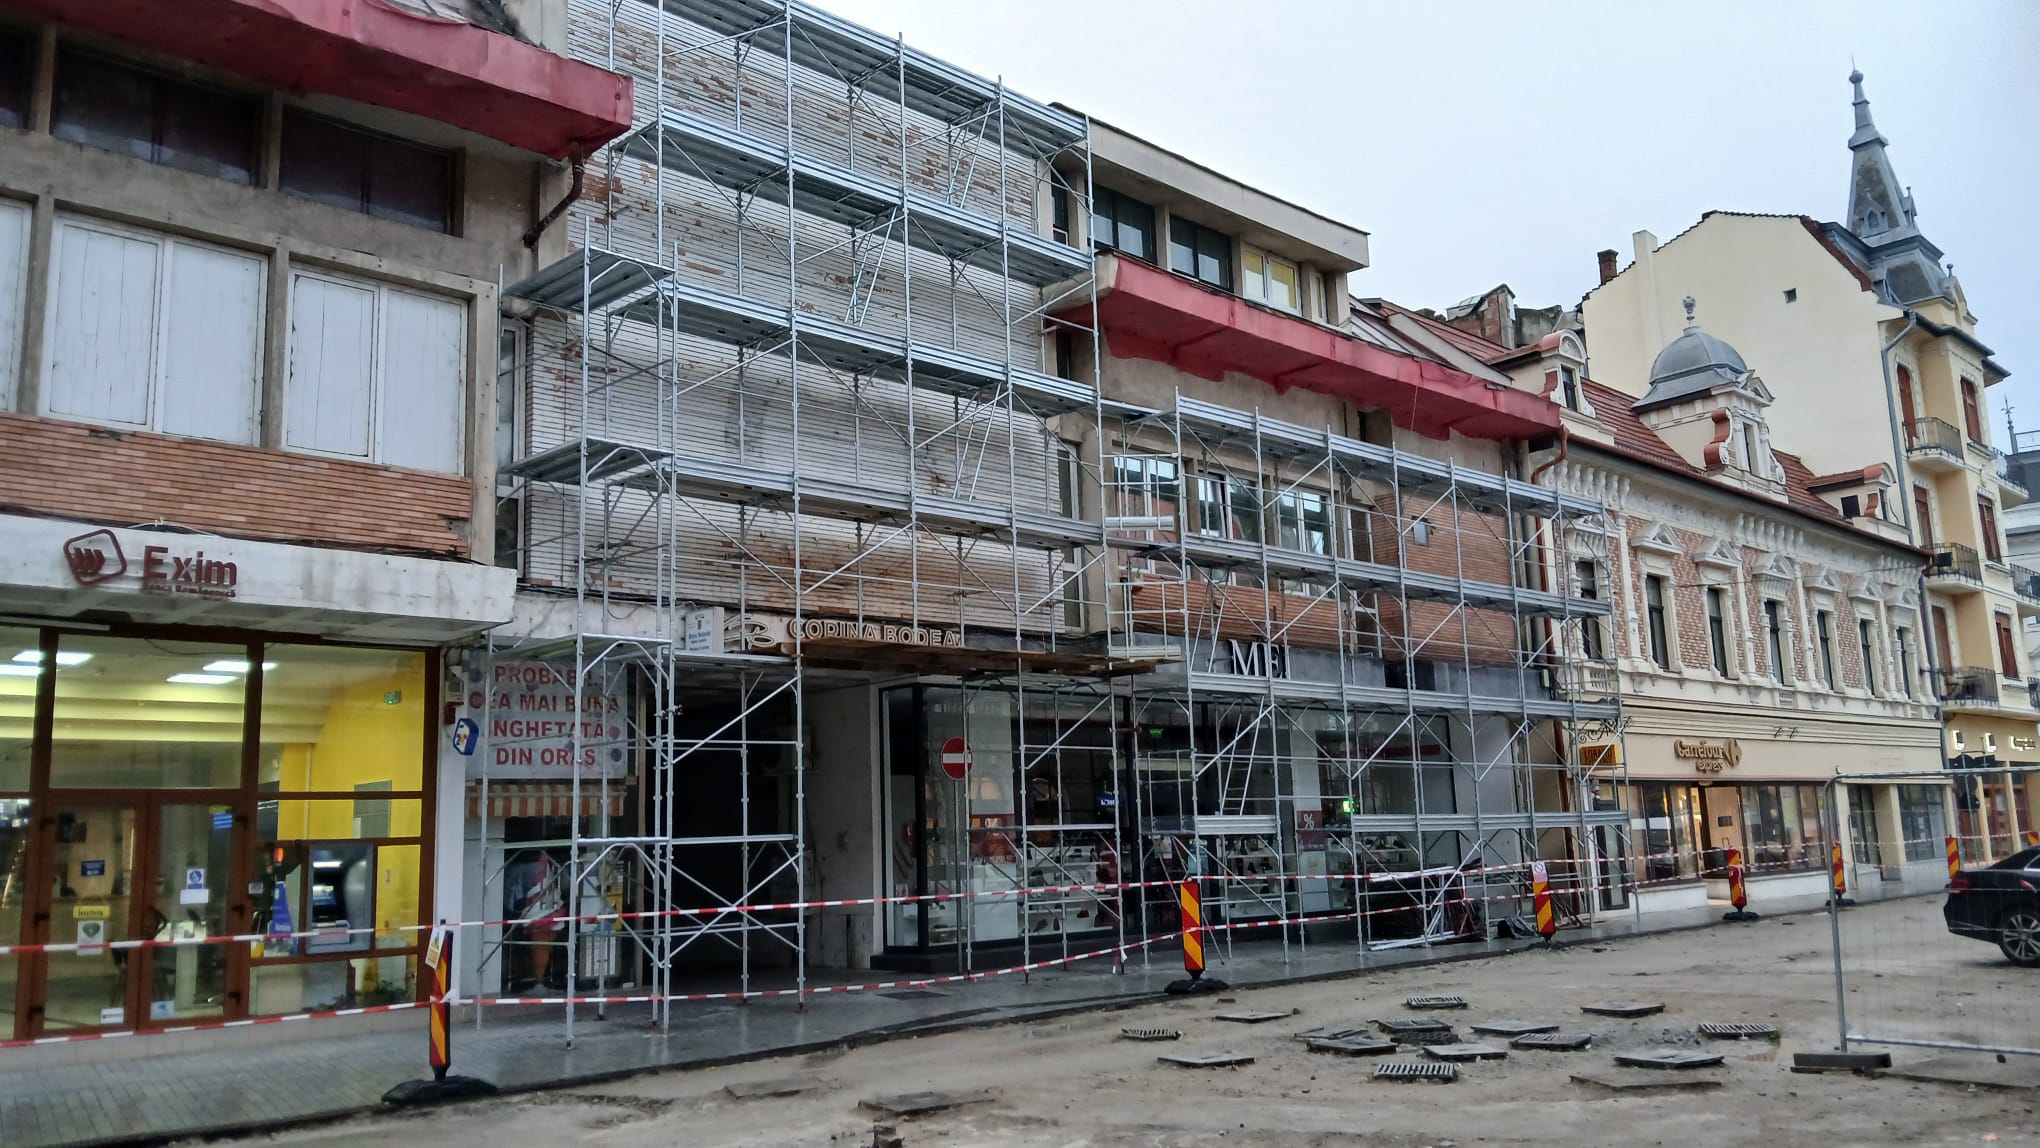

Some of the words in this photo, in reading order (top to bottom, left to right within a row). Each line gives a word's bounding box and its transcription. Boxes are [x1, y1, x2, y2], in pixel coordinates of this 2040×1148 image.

[143, 545, 237, 585] Exim
[520, 694, 557, 712] MAI
[496, 748, 532, 765] DIN
[540, 749, 596, 766] ORS
